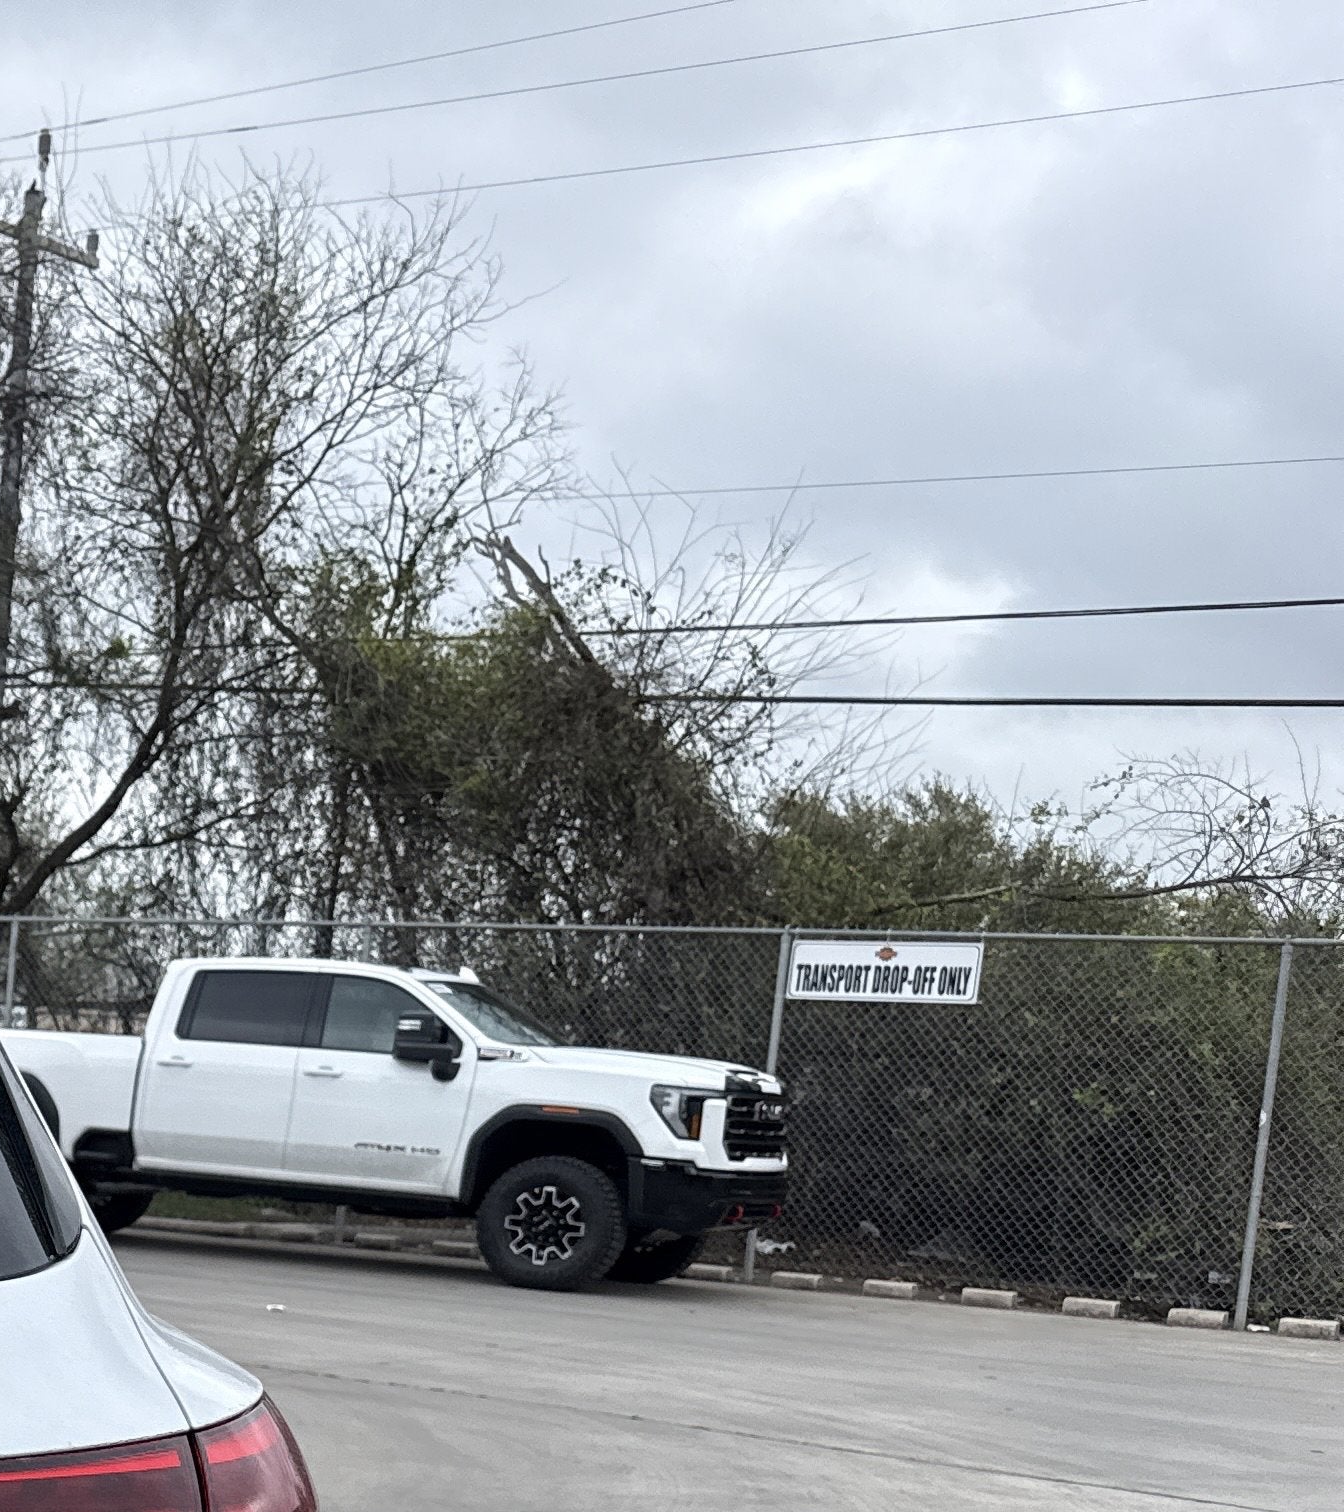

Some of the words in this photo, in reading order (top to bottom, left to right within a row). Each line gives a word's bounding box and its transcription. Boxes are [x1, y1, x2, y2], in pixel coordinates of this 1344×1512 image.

[795, 964, 871, 993] TRANSPORT
[872, 965, 937, 995] DROP-OFF
[937, 966, 972, 996] ONLY
